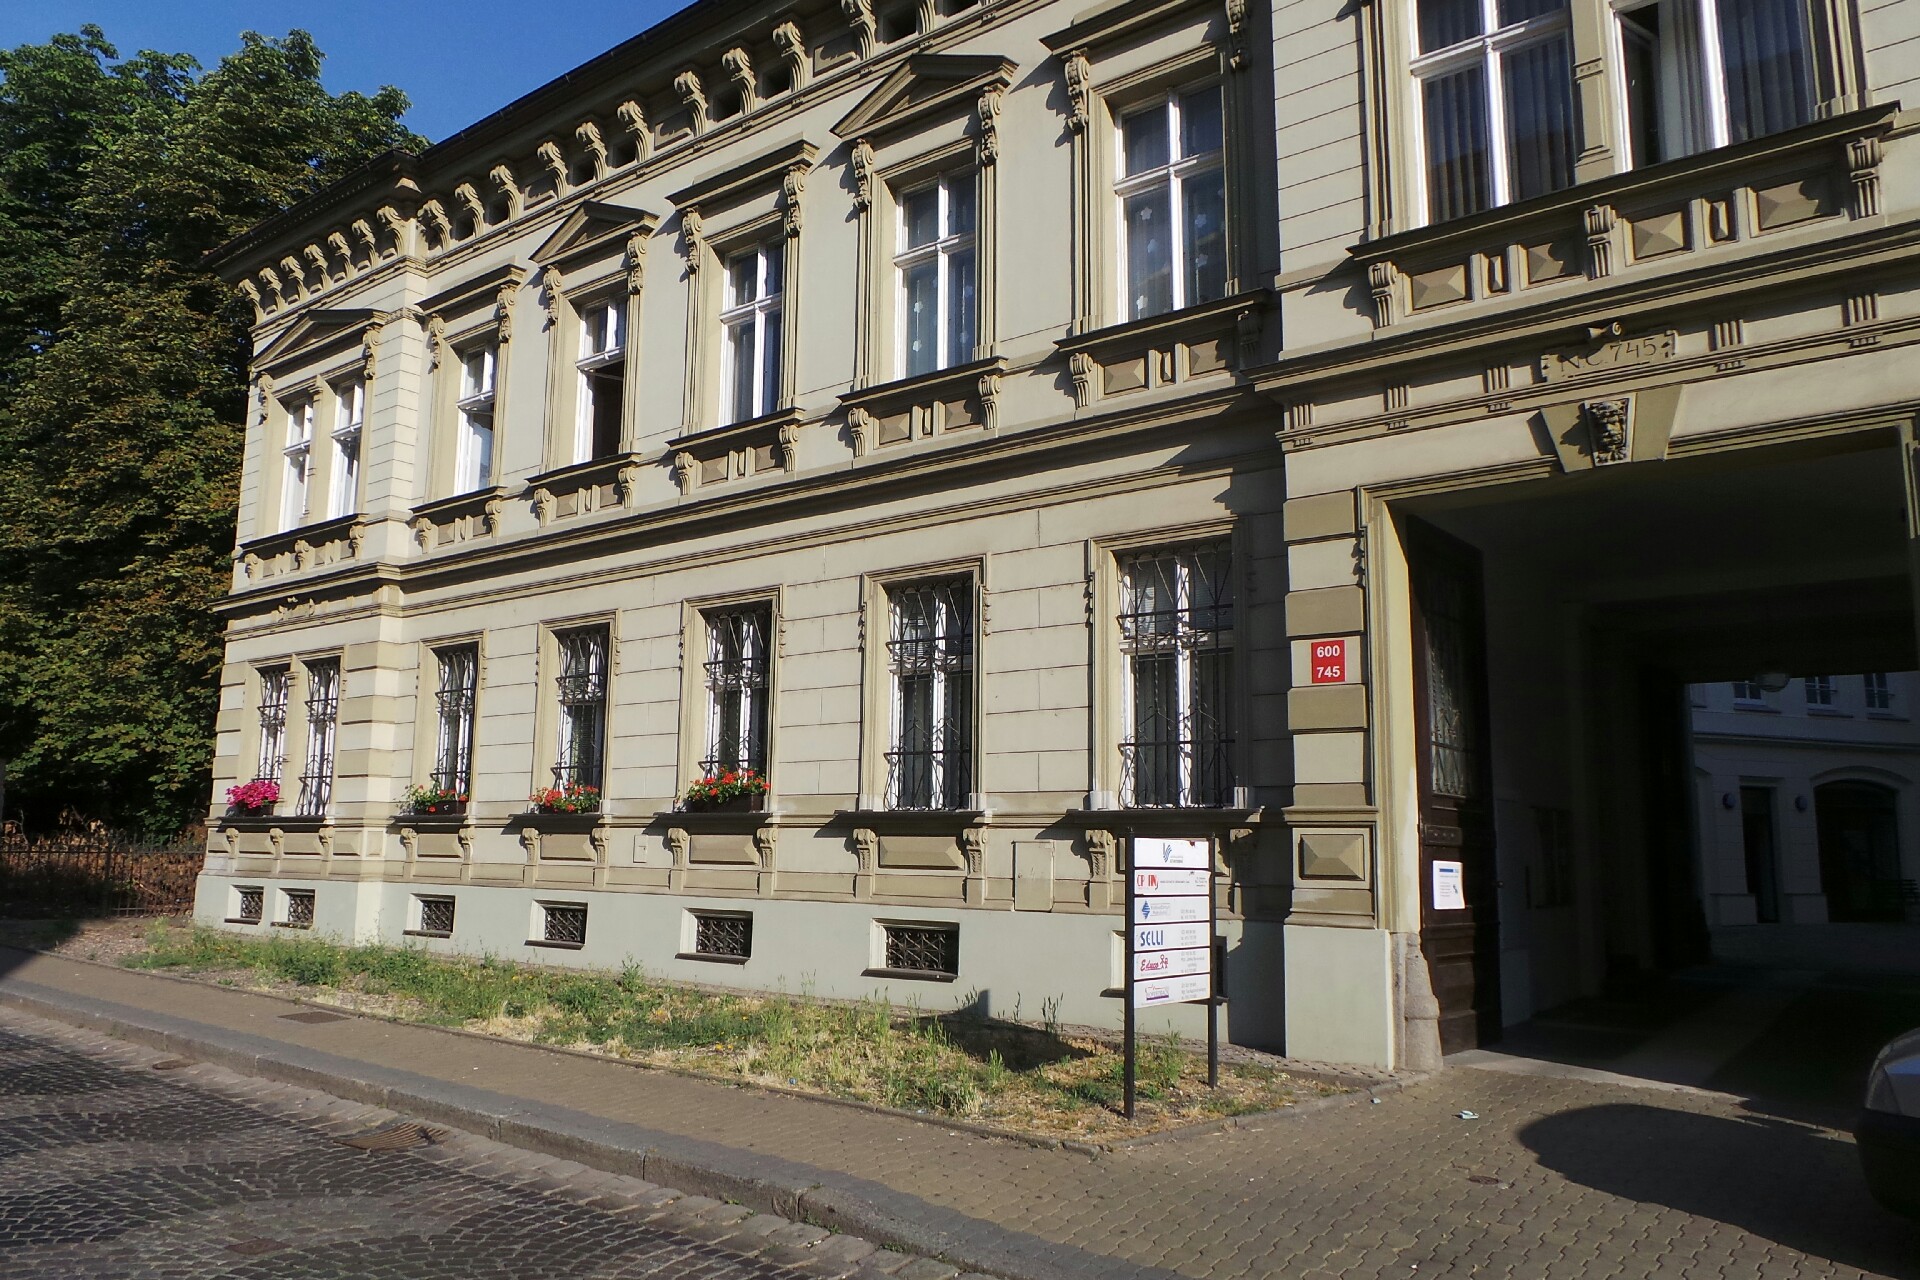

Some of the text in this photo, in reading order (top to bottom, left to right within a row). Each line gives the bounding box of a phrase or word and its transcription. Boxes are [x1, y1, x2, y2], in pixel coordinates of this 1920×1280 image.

[1316, 645, 1340, 657] 600
[1316, 666, 1340, 678] 745
[1140, 929, 1164, 947] SELLI
